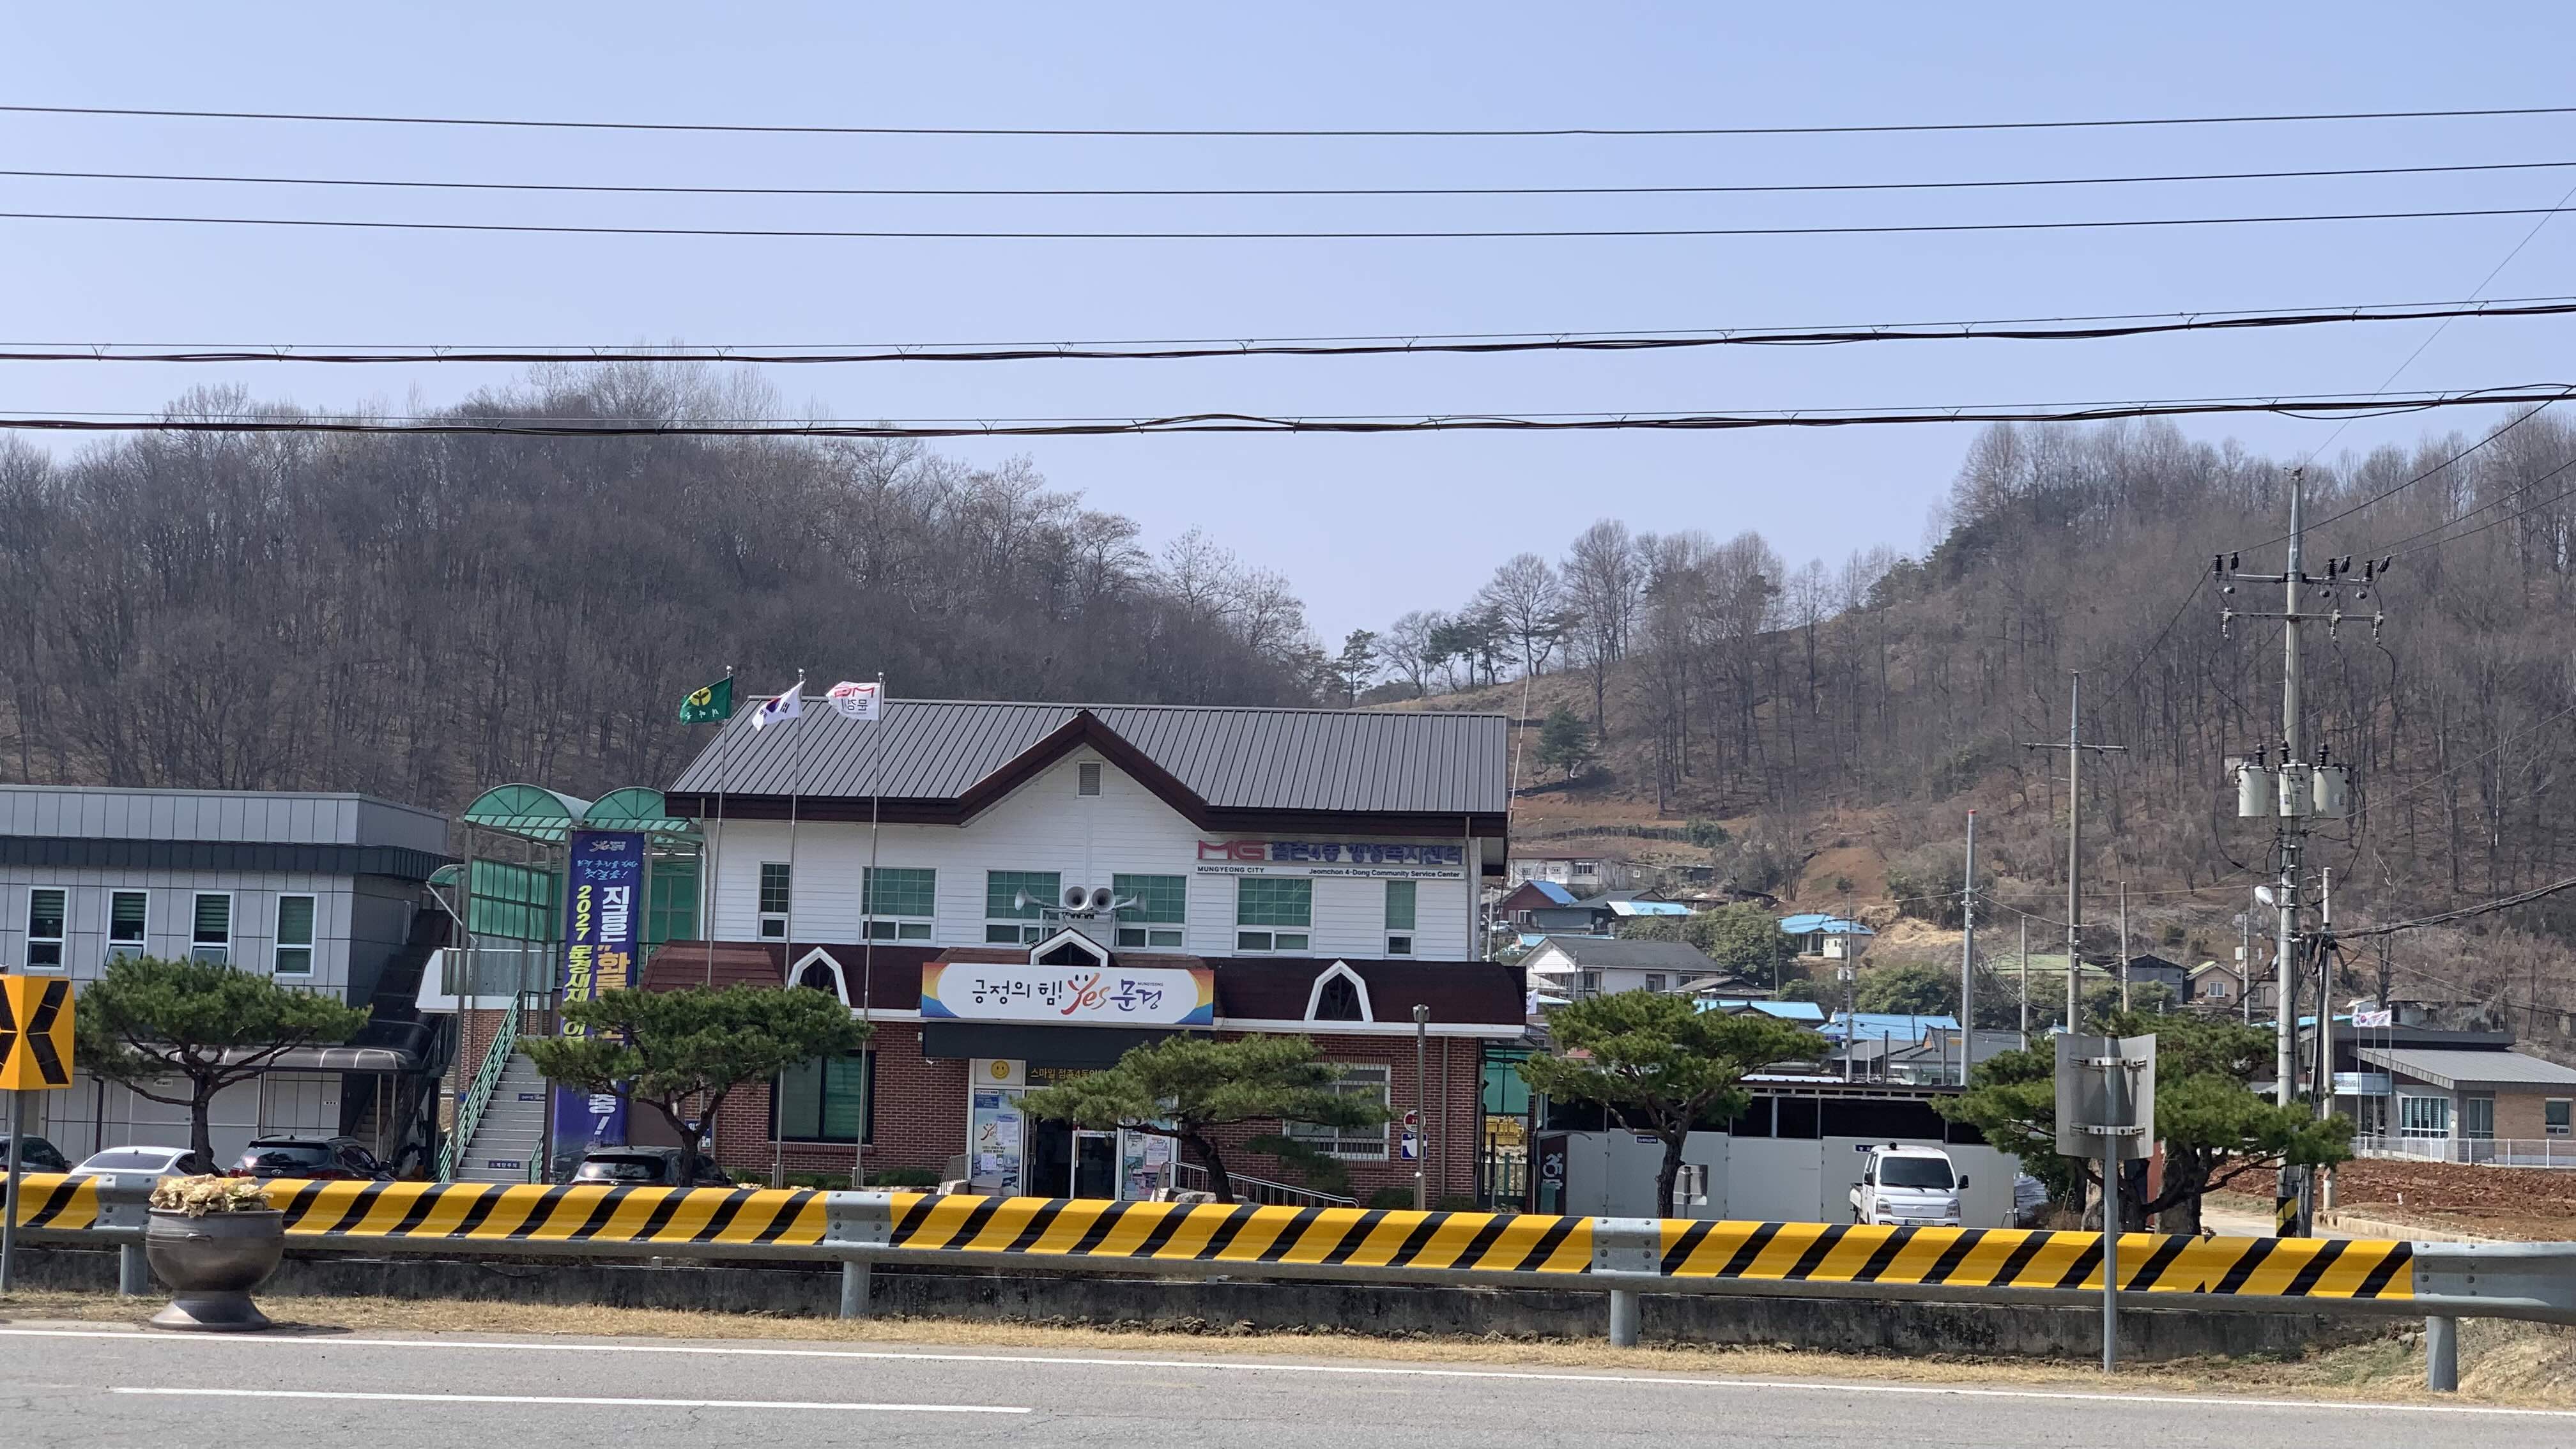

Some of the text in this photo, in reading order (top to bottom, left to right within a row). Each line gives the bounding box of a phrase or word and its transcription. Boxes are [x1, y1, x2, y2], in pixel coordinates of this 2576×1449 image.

[1198, 839, 1462, 865] MG 점촌4동 행정복지센터
[1345, 870, 1370, 878] 4-Dong
[576, 885, 593, 941] 2027
[600, 885, 631, 942] 지금은
[972, 972, 1163, 1015] 긍정의 힘! Yes 문경
[1031, 1068, 1055, 1079] 스마일
